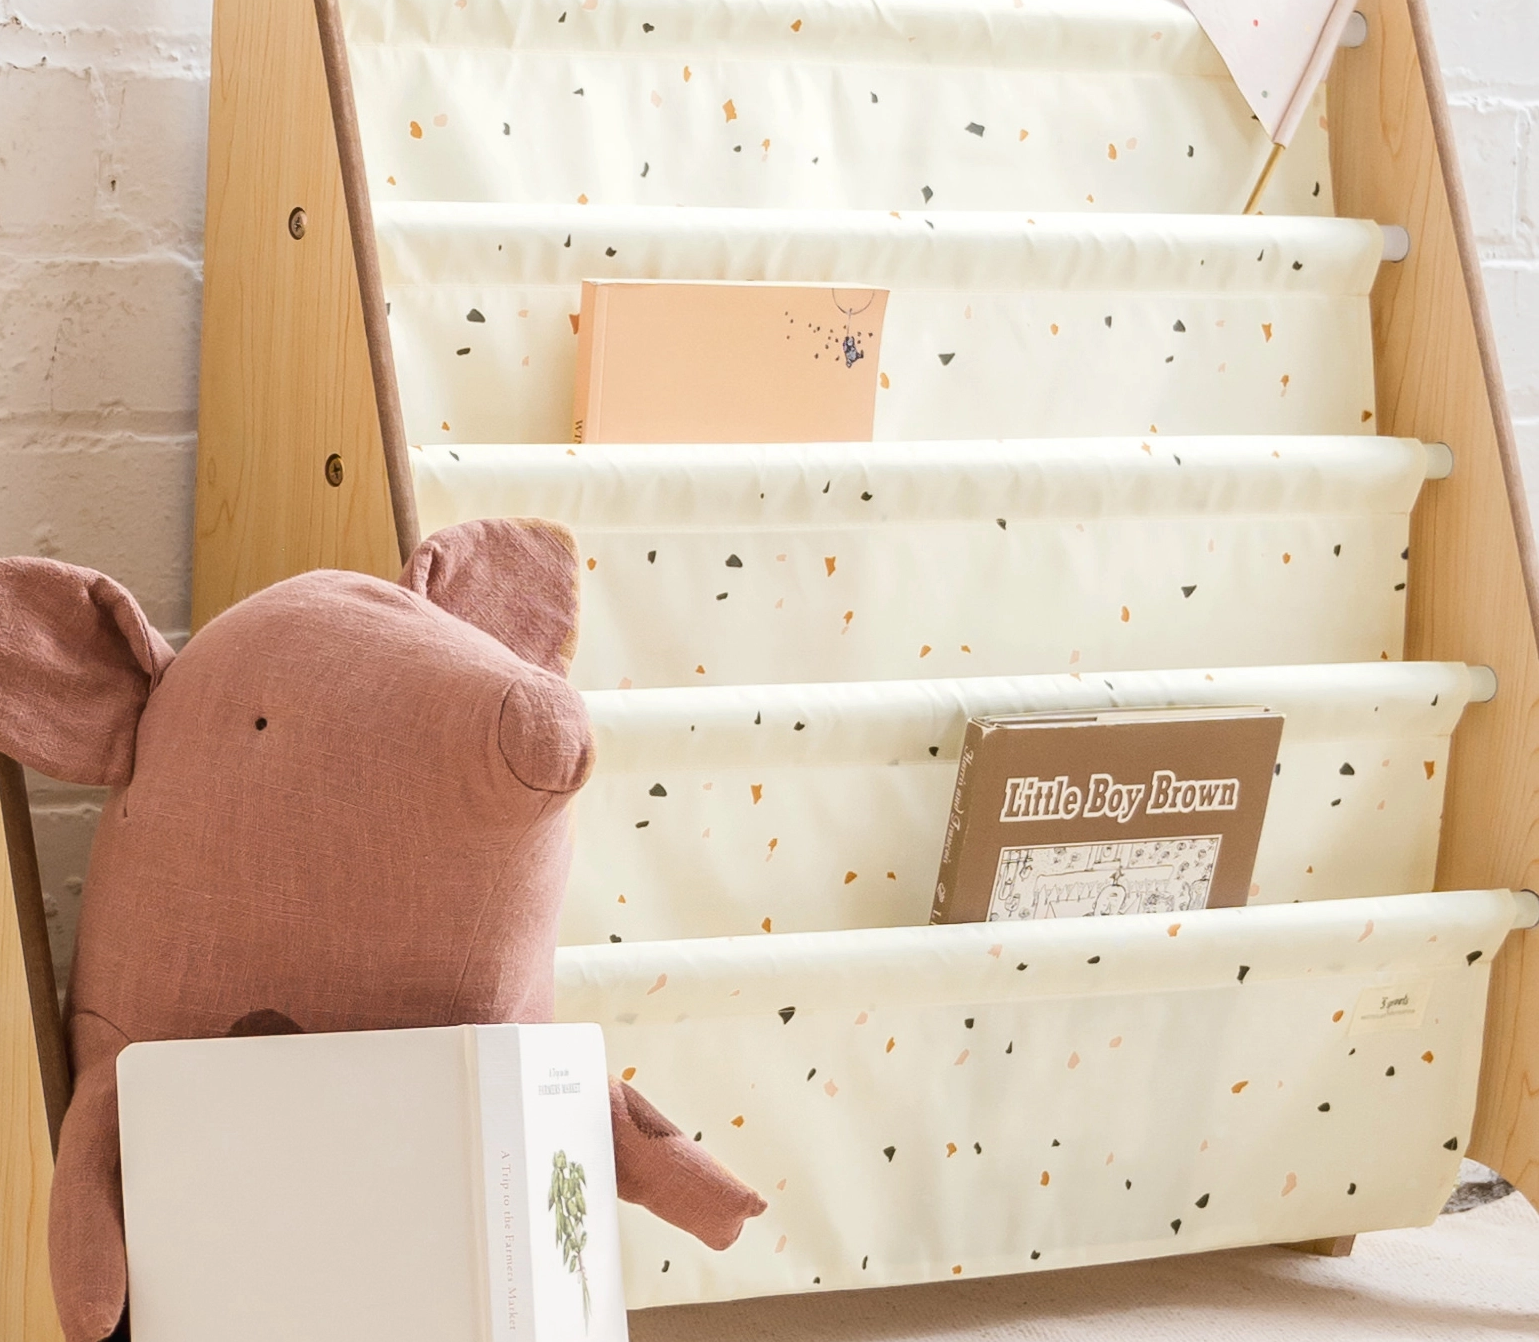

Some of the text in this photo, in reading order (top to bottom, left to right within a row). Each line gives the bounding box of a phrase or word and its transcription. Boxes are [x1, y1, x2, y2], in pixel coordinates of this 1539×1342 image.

[953, 788, 964, 814] and
[1000, 769, 1240, 823] Little Boy Brown
[501, 1150, 510, 1159] A
[500, 1164, 511, 1189] Trip
[508, 1287, 518, 1330] Market
